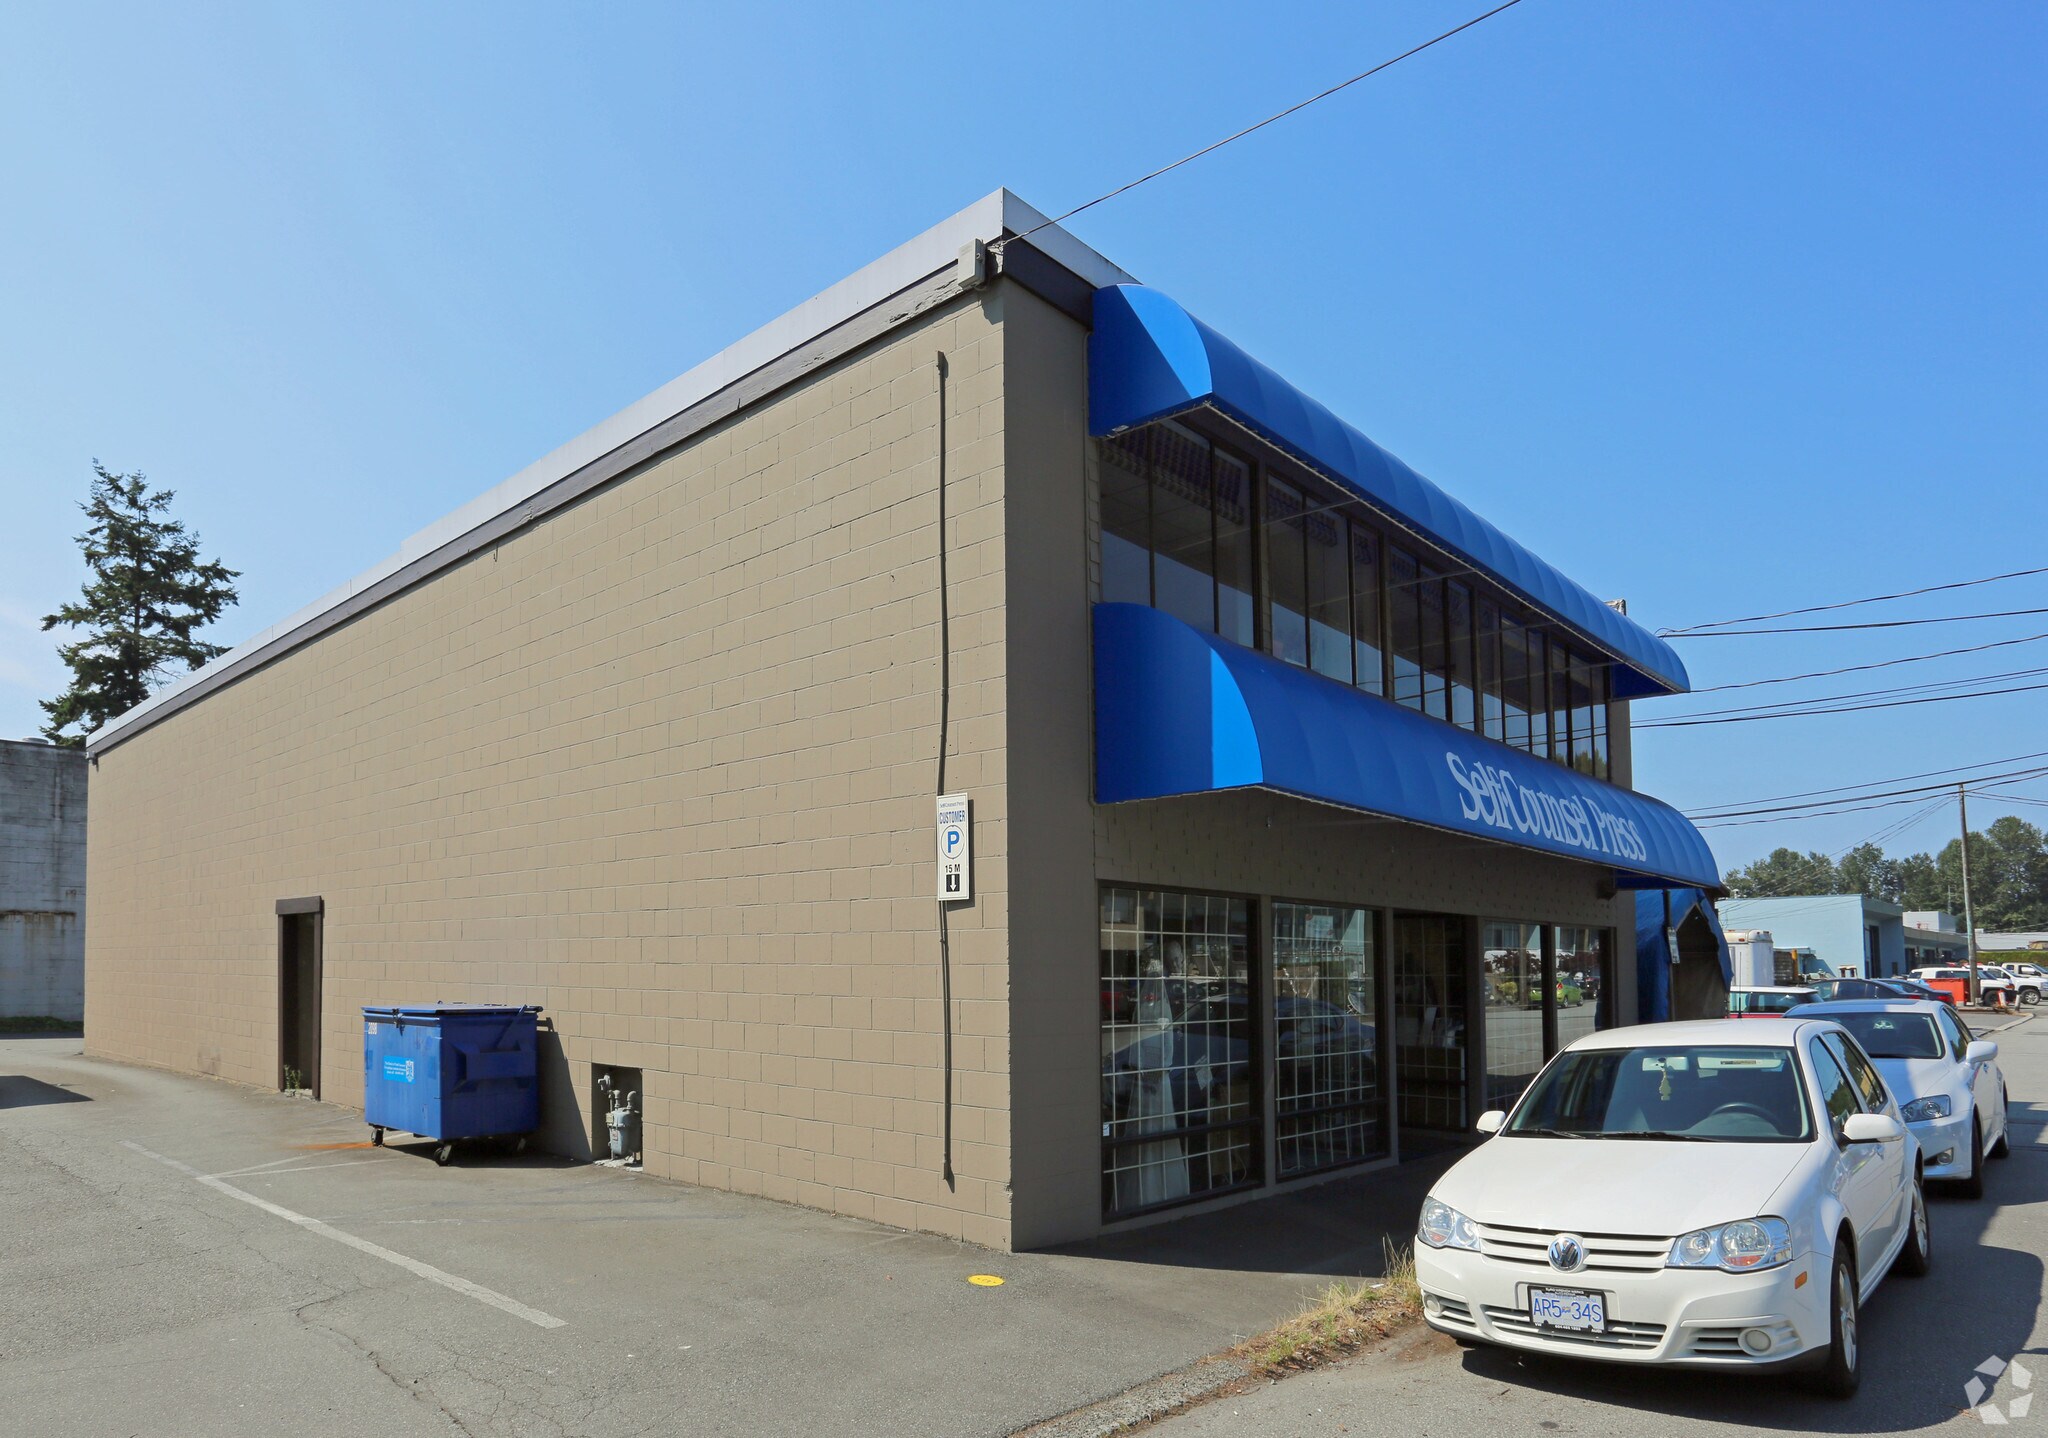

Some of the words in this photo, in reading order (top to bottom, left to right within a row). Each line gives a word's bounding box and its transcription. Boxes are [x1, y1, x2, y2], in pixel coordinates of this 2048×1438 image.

[940, 810, 965, 824] CUSTOMER
[1582, 796, 1647, 862] Press
[948, 831, 960, 854] P
[945, 865, 953, 873] 15
[954, 864, 961, 872] M
